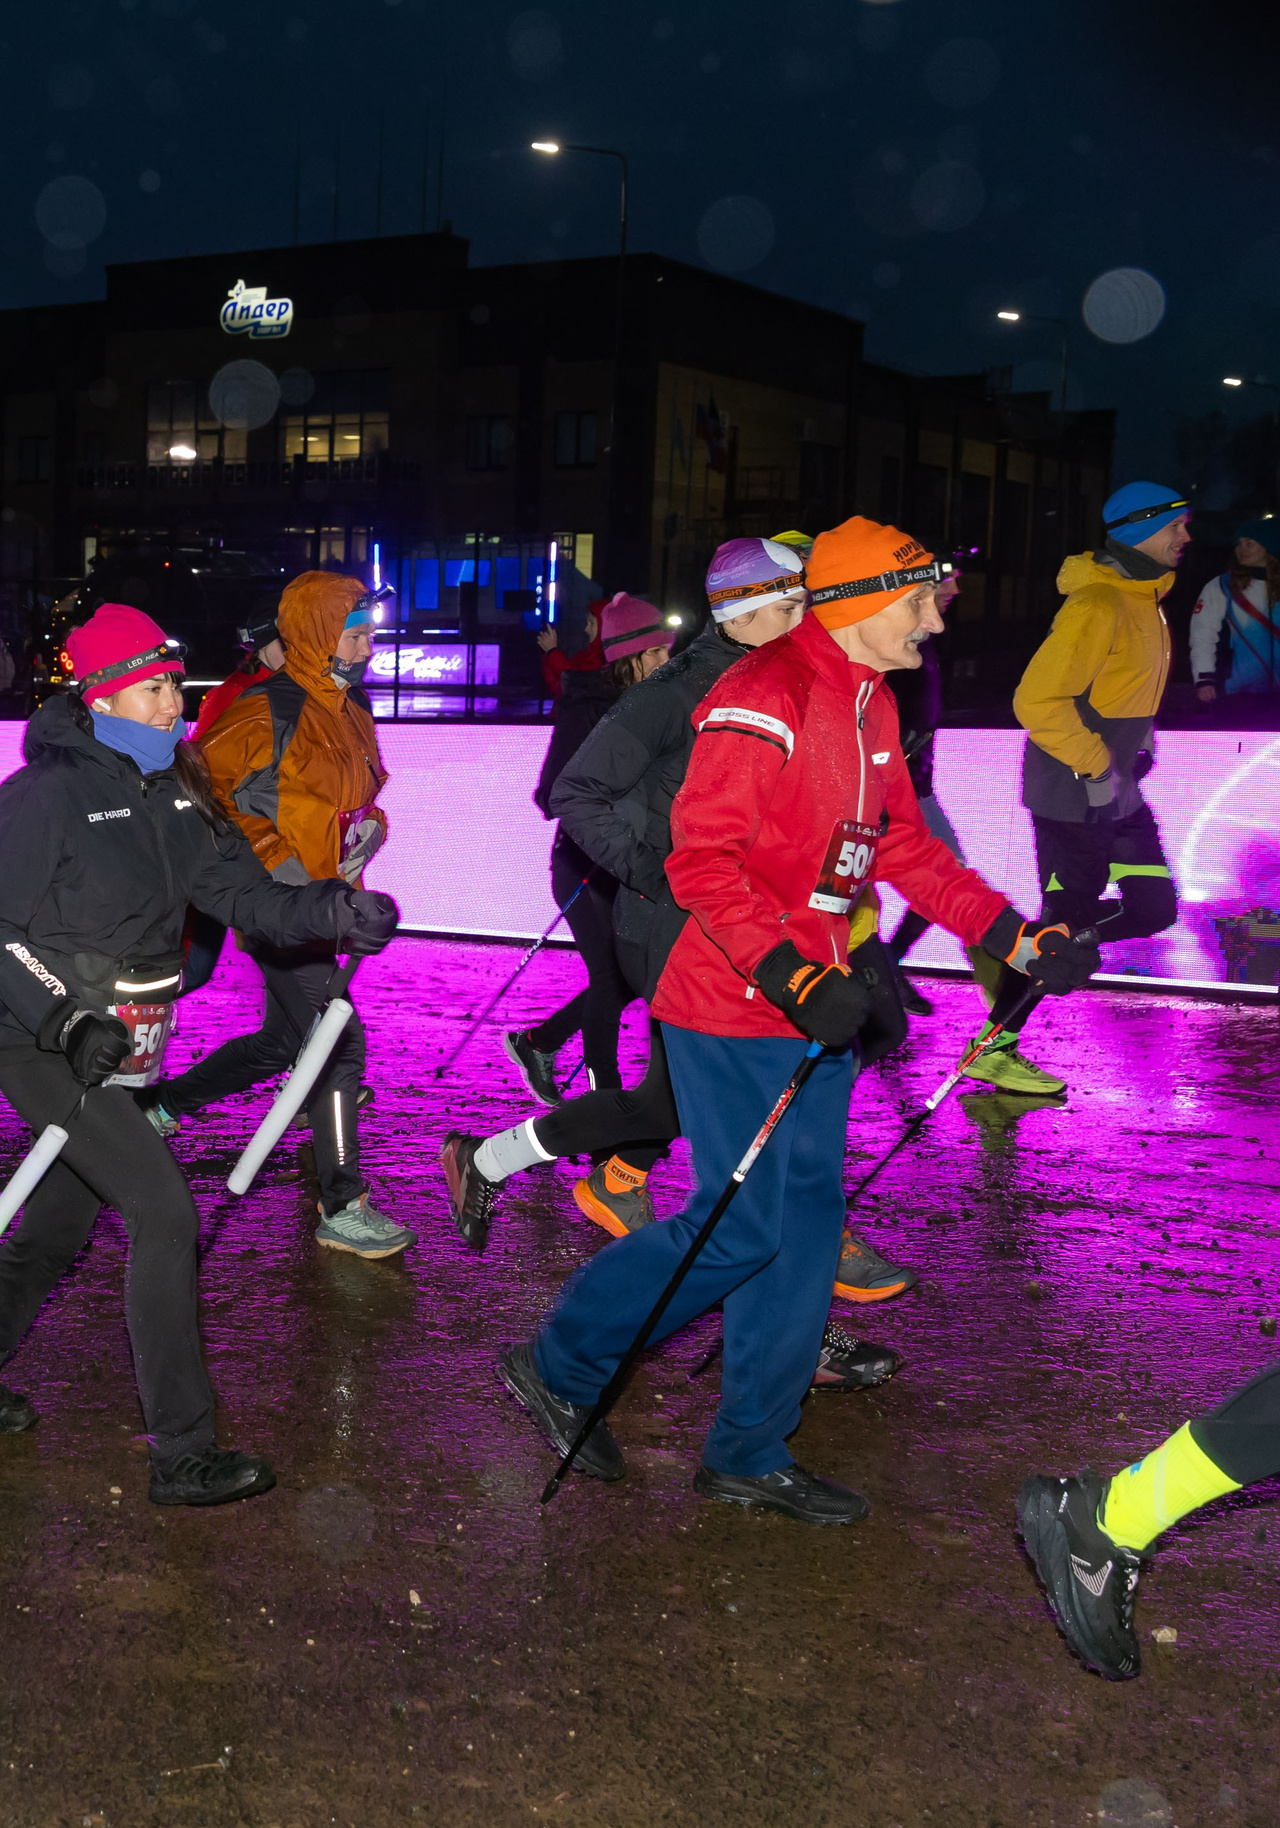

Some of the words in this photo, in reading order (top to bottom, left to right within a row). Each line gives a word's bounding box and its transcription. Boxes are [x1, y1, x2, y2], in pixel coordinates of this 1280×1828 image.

[222, 301, 290, 323] Лидер
[127, 658, 143, 669] LED
[145, 652, 160, 661] HEA
[751, 716, 776, 727] LINE
[87, 812, 104, 822] DIE
[104, 808, 131, 819] HARD
[134, 1021, 167, 1057] 50
[611, 1166, 639, 1185] СТИЛЬ
